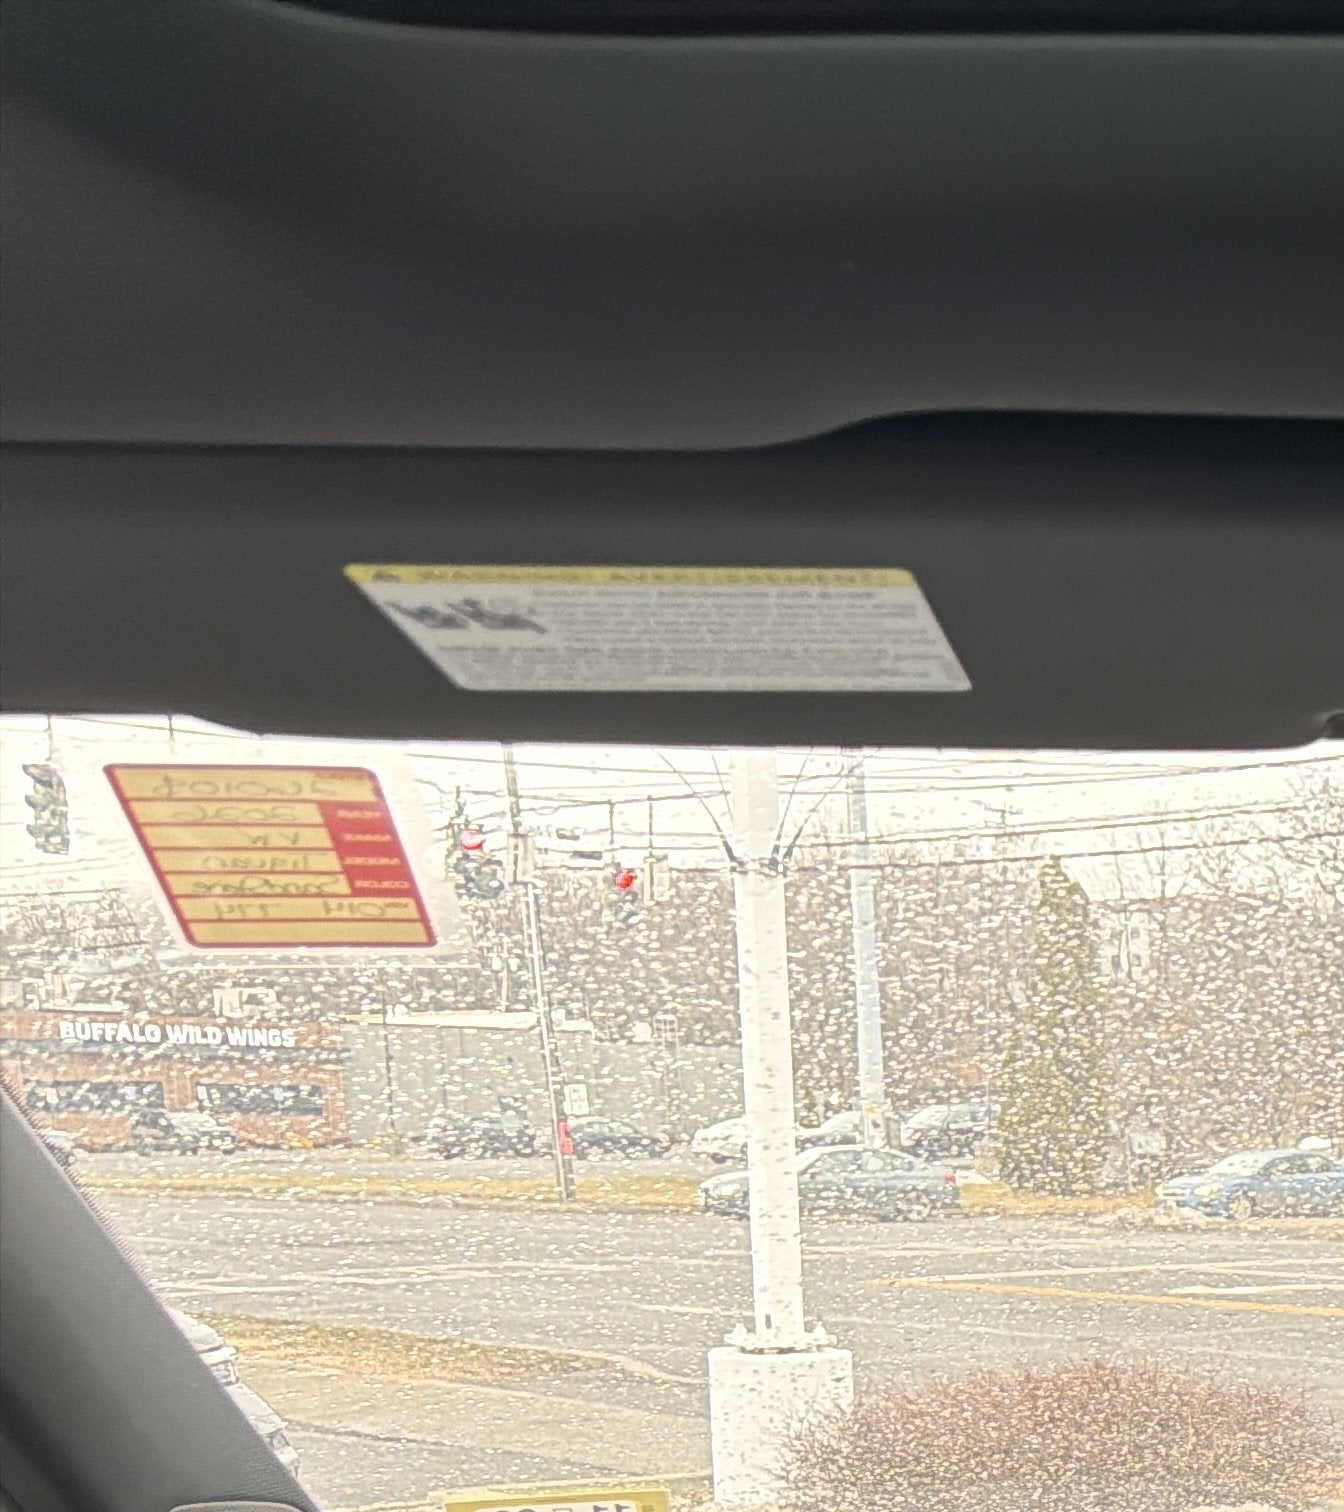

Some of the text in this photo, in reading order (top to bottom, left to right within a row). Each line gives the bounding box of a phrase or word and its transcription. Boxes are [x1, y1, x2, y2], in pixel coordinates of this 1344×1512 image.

[58, 1021, 297, 1048] BUFFALO WILD WINGS
